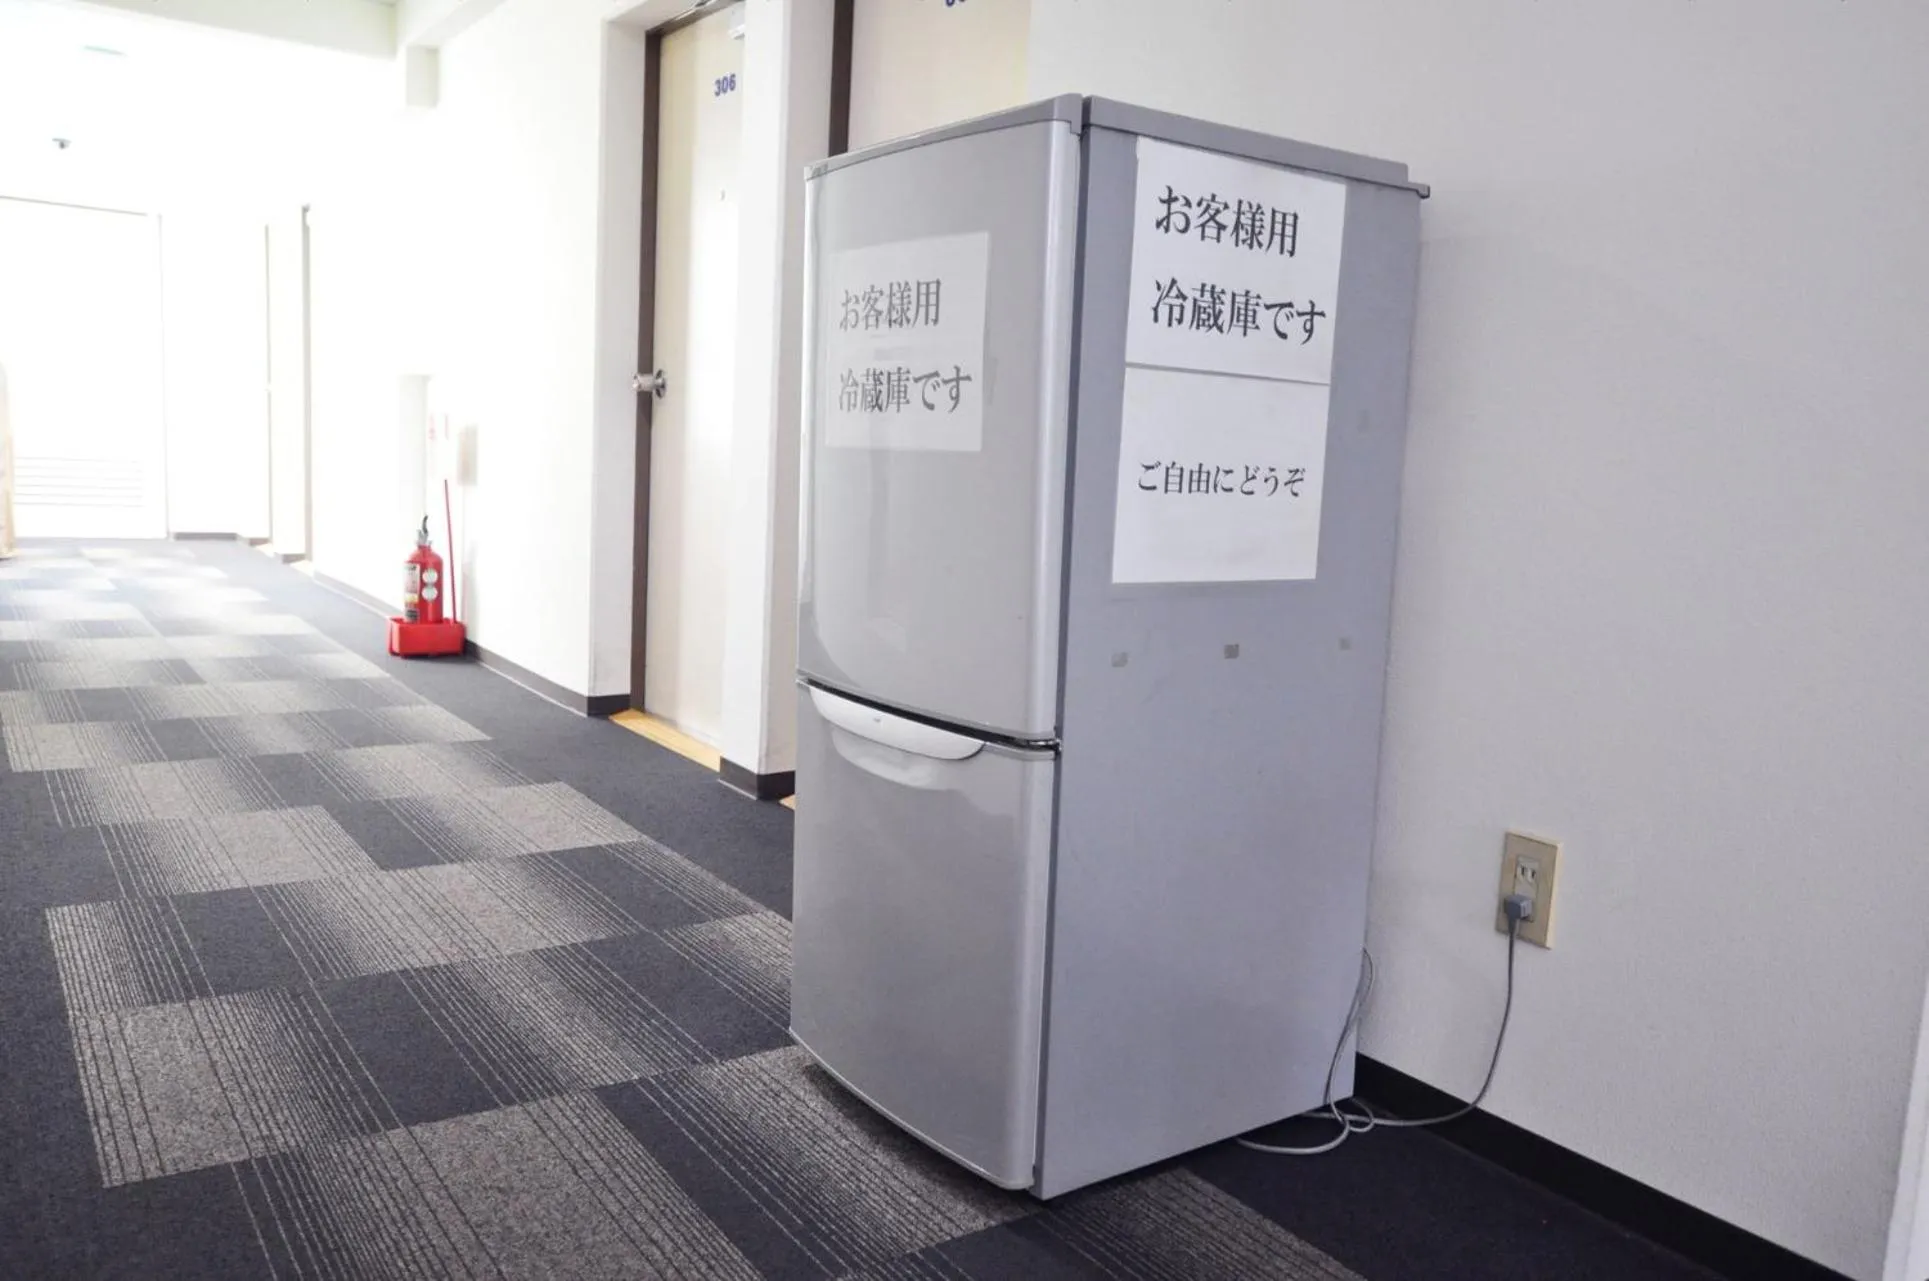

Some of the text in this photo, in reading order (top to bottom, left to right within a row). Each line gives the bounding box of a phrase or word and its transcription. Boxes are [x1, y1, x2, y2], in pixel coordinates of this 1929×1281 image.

[714, 73, 736, 97] 306
[1155, 185, 1298, 257] お客様用
[839, 278, 941, 332] お客様用
[1152, 277, 1326, 345] 冷蔵庫です
[839, 365, 972, 413] 冷蔵庫です
[1138, 460, 1305, 497] ご自由にどうぞ
